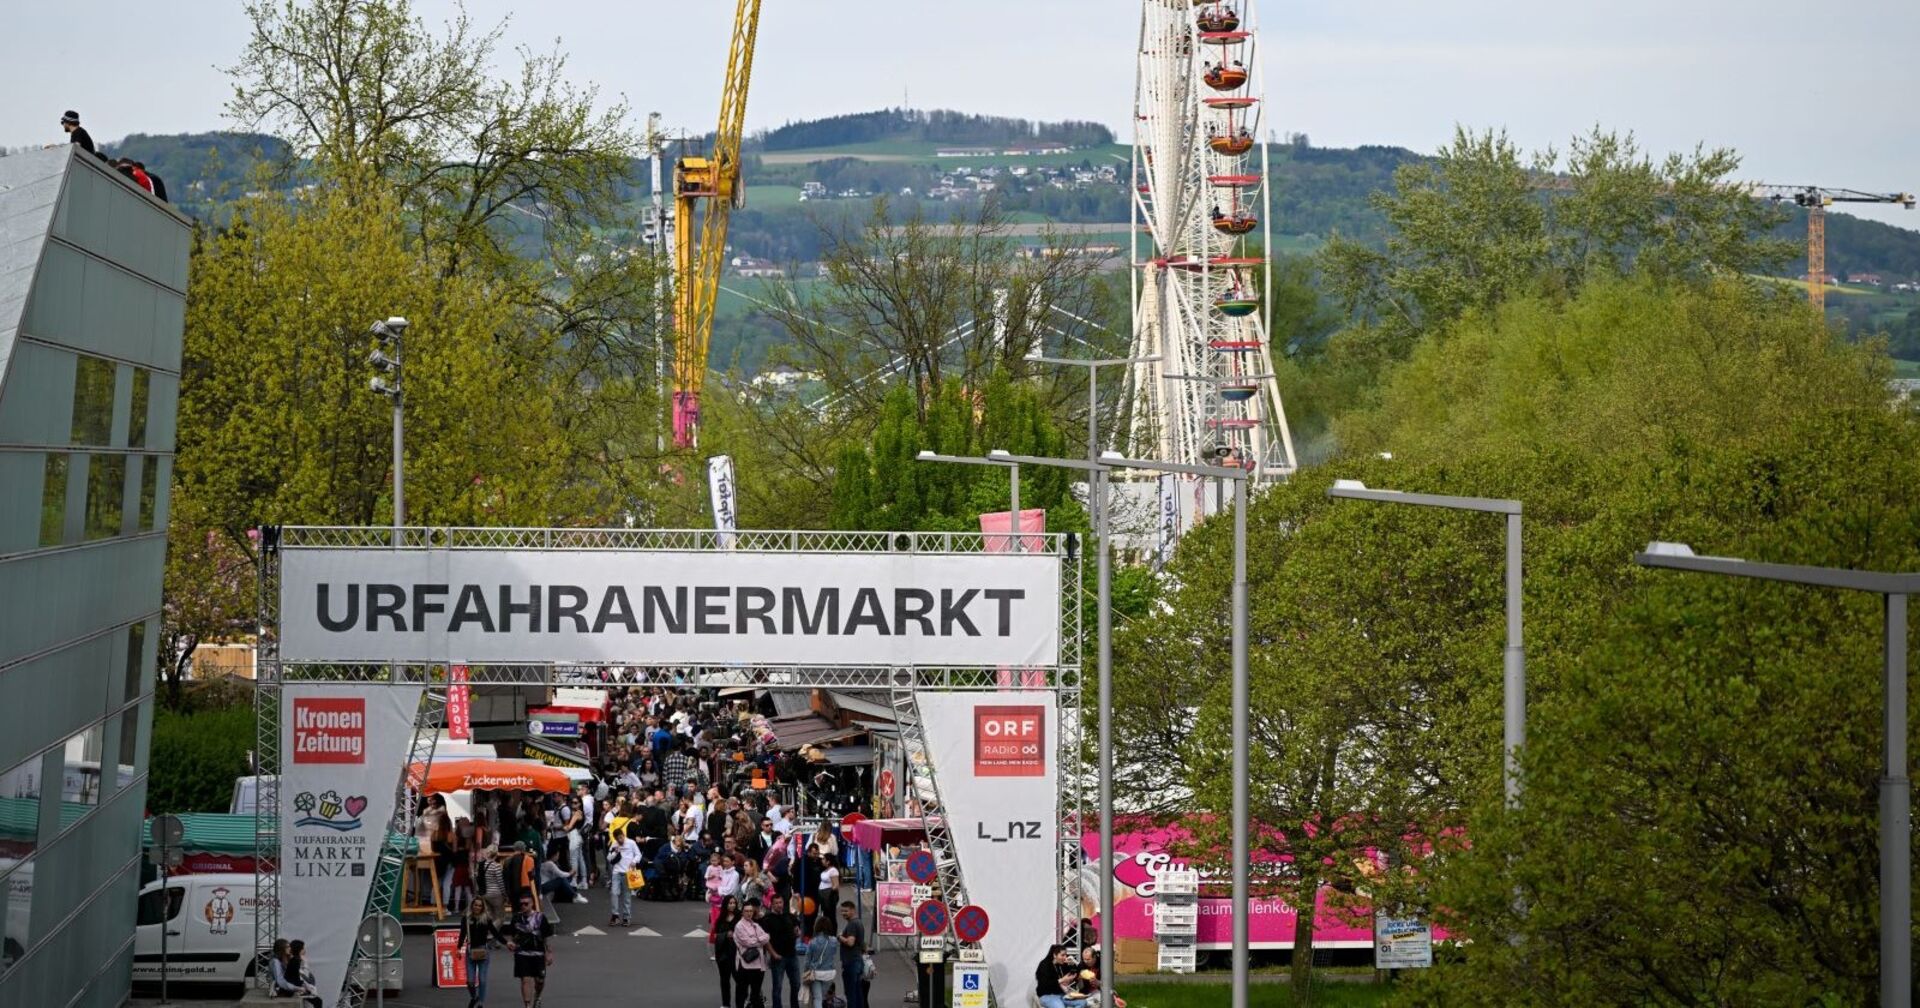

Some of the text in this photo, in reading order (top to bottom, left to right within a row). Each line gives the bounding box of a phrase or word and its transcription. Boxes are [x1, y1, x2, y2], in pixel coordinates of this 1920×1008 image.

[317, 583, 1025, 637] URFAHRANERMARKT
[296, 707, 362, 729] Kronen
[984, 720, 1034, 736] ORF
[297, 731, 362, 755] Zeitung
[984, 745, 1018, 754] RADIO
[464, 775, 534, 786] Zuckerwatte
[294, 836, 366, 844] URFAHRANER
[294, 846, 366, 860] MARKT
[192, 863, 233, 871] ORIGINAL
[294, 862, 347, 877] LINZ
[913, 886, 929, 895] Ende
[239, 897, 281, 907] CHINA-GOL
[963, 951, 979, 959] Ende
